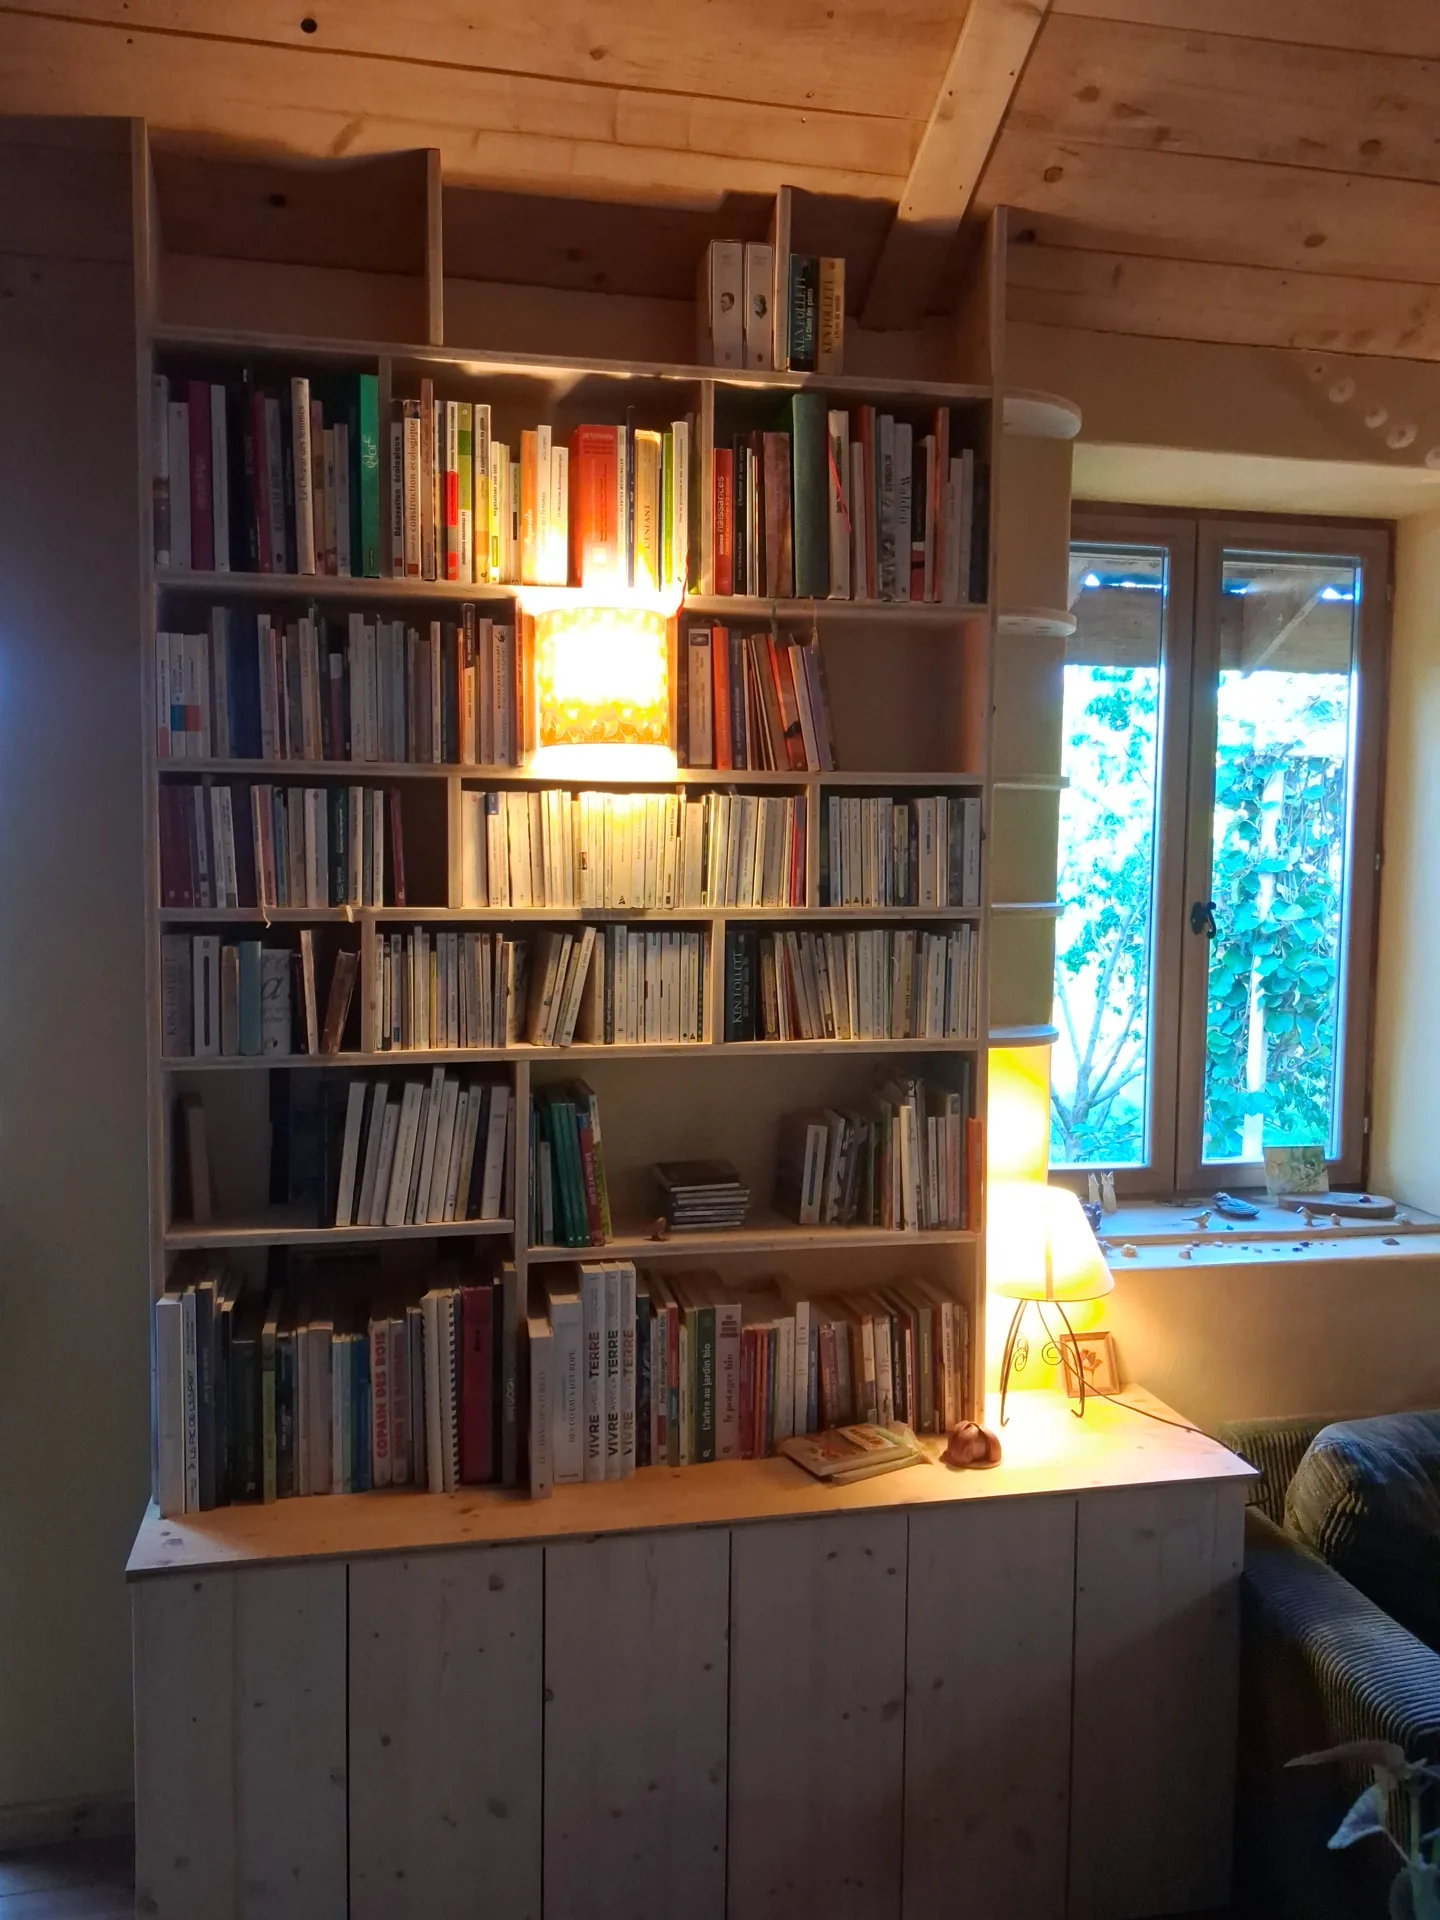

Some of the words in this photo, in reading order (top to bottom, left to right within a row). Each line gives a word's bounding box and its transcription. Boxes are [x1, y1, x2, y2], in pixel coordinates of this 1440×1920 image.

[794, 277, 806, 325] FOLLETT
[794, 328, 805, 352] KEN
[297, 405, 306, 440] femmes
[298, 441, 307, 456] des
[393, 436, 402, 483] écologique
[407, 419, 418, 471] écologique
[300, 490, 307, 500] Le
[408, 473, 417, 532] construction
[716, 476, 724, 533] naissances
[899, 476, 911, 525] Walden
[393, 489, 402, 537] Rénovation
[643, 504, 651, 549] L'ENFANT
[732, 949, 743, 996] FOLLETT
[166, 1010, 177, 1036] KEN
[732, 1000, 743, 1024] KEN
[658, 1315, 666, 1328] bio
[374, 1331, 386, 1366] BOIS
[588, 1331, 600, 1379] TERRE
[607, 1330, 618, 1378] TERRE
[622, 1329, 633, 1377] TERRE
[702, 1343, 711, 1358] bio
[723, 1353, 734, 1371] bio
[375, 1371, 387, 1398] DES
[659, 1357, 667, 1386] élevage
[701, 1359, 713, 1386] jardin
[505, 1377, 515, 1405] GOGH
[568, 1391, 576, 1426] OISEAUX
[704, 1388, 711, 1399] au
[724, 1372, 735, 1412] potager
[188, 1413, 196, 1427] DE
[376, 1403, 388, 1459] COPAIN
[622, 1411, 633, 1456] VIVRE
[702, 1401, 711, 1431] L'arbre
[188, 1428, 196, 1445] PIC
[568, 1427, 576, 1443] DES
[589, 1415, 600, 1459] VIVRE
[607, 1412, 618, 1456] VIVRE
[189, 1446, 197, 1460] LE
